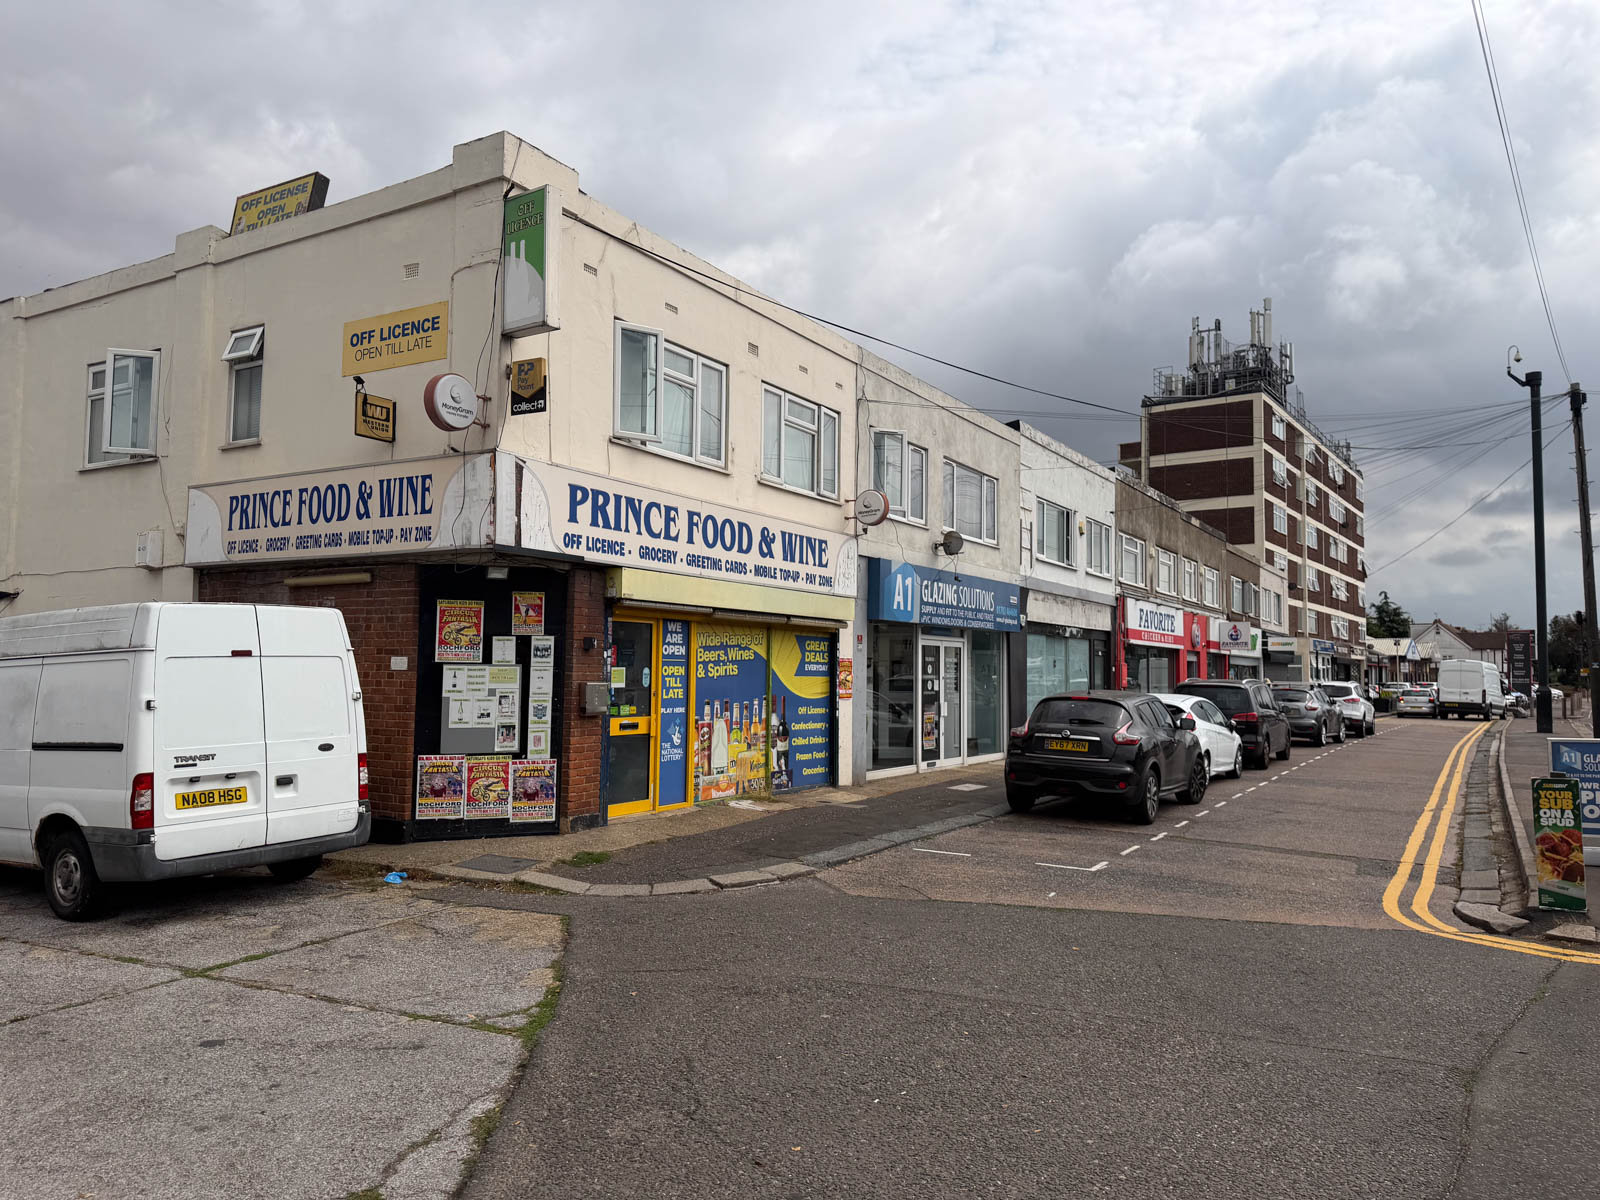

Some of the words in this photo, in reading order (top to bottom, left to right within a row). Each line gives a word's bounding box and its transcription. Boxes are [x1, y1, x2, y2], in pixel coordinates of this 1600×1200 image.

[241, 197, 262, 212] OFF
[263, 182, 309, 205] LICENSE
[257, 203, 286, 220] OPEN
[517, 200, 535, 216] OFF
[507, 212, 544, 235] LICENCE
[350, 330, 375, 347] OFF
[380, 316, 440, 341] LICENCE
[355, 346, 382, 361] OPEN
[385, 342, 404, 355] TILL
[407, 336, 432, 352] LATE
[442, 402, 474, 416] MoneyGram
[370, 425, 389, 433] UNION
[228, 489, 293, 531] PRINCE
[297, 483, 350, 526] FOOD
[356, 480, 373, 520] &
[378, 474, 433, 518] WINE
[568, 483, 680, 543] PRINCE
[686, 509, 753, 555] FOOD
[758, 526, 776, 559] &
[780, 530, 829, 568] WINE
[227, 540, 237, 555] OFF
[238, 538, 259, 554] LICENCE
[266, 536, 291, 552] GROCERY
[295, 533, 322, 550] GREETING
[324, 532, 343, 548] CARDS
[348, 529, 370, 546] MOBILE
[372, 528, 394, 545] TOP-UP
[400, 527, 413, 543] PAY
[415, 526, 432, 542] ZONE
[563, 532, 583, 550] OFF
[586, 536, 626, 557] LICENCE
[638, 545, 678, 565] GROCERY
[686, 553, 722, 572] GREETING
[725, 559, 748, 576] CARDS
[754, 564, 778, 580] MOBILE
[779, 568, 800, 582] TOP-UP
[806, 574, 818, 587] PAY
[818, 574, 833, 588] ZONE
[893, 574, 912, 612] A1
[922, 580, 957, 606] GLAZING
[959, 586, 995, 612] SOLUTIONS
[921, 605, 936, 615] SUPPLY
[937, 607, 945, 615] AND
[965, 610, 976, 619] PUBLIC
[442, 615, 478, 623] FANTASIA
[1139, 608, 1175, 633] FAVORITE
[667, 622, 682, 632] WE
[665, 634, 683, 644] ARE
[697, 632, 721, 647] Wide
[723, 632, 752, 648] Range
[753, 632, 764, 646] of
[662, 645, 686, 656] OPEN
[805, 640, 828, 651] GREAT
[727, 647, 755, 661] Wines
[805, 652, 829, 663] DEALS
[662, 666, 685, 676] OPEN
[697, 663, 706, 678] &
[708, 662, 739, 680] Spirits
[665, 677, 682, 687] TILL
[663, 689, 684, 699] LATE
[798, 706, 807, 715] Off
[807, 705, 826, 714] License
[791, 721, 826, 730] Confectionery
[792, 736, 809, 746] Chilled
[810, 735, 826, 744] Drinks
[1049, 741, 1070, 749] EY67
[1071, 742, 1087, 750] XRN
[174, 754, 216, 763] TRANSIT
[661, 754, 681, 762] LOTTERY
[796, 752, 812, 760] Frozen
[813, 750, 825, 759] Food
[1562, 752, 1576, 763] A1
[470, 771, 506, 779] FANTASIA
[802, 765, 825, 775] Groceries
[182, 791, 215, 807] NA08
[218, 789, 242, 802] HSG
[1538, 790, 1573, 799] YOUR
[1539, 799, 1574, 810] SUB
[1540, 808, 1561, 818] ON
[1563, 810, 1574, 819] A
[1540, 818, 1575, 827] SPUD
